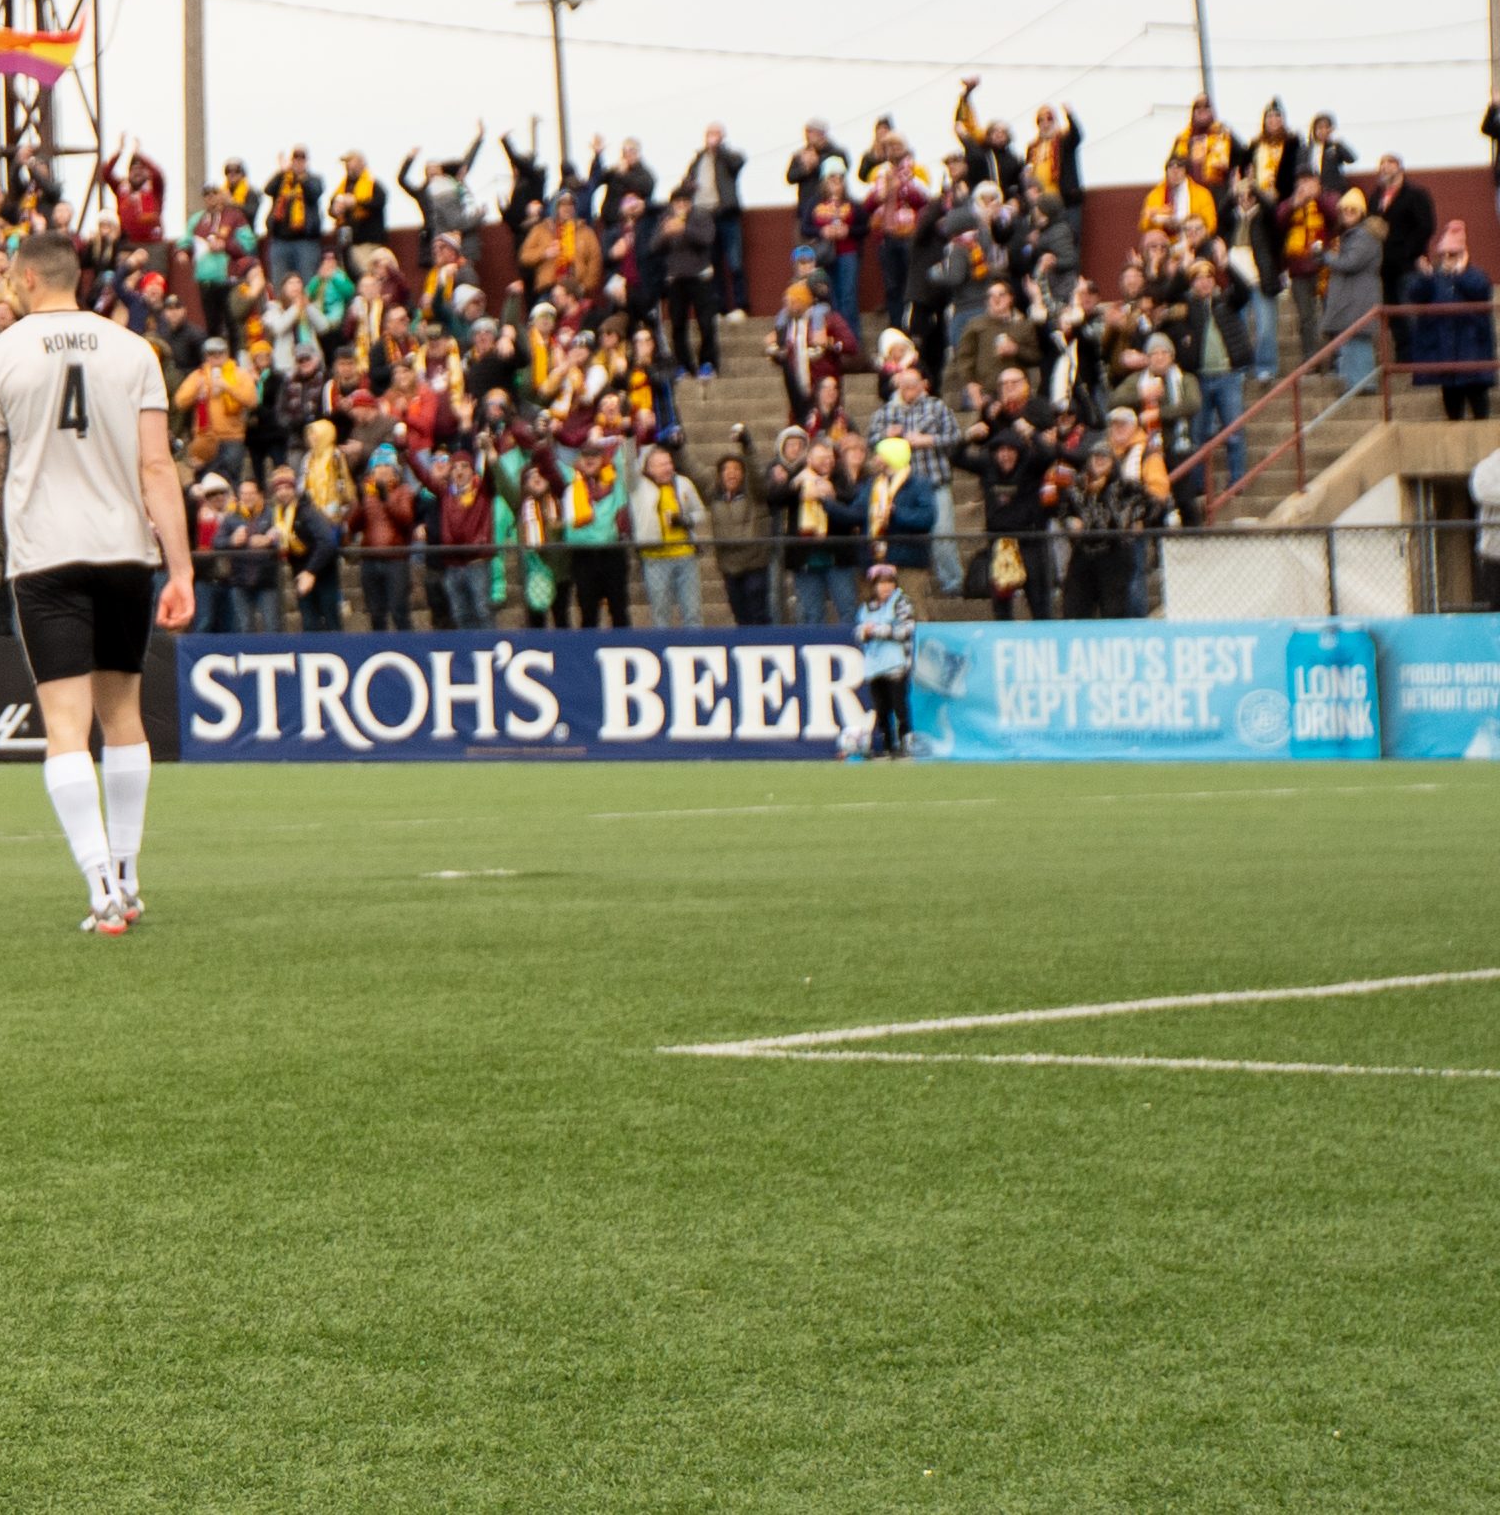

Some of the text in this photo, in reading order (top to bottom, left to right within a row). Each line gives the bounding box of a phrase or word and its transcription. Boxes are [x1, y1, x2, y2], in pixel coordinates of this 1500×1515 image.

[42, 332, 98, 354] ROMEO
[58, 363, 88, 439] 4
[994, 635, 1259, 685] FINLAND'S BEST
[1293, 664, 1368, 699] LONG
[190, 640, 877, 752] STROH'S BEER
[996, 683, 1080, 728] KEPT
[1088, 682, 1220, 728] SECRET.
[1401, 687, 1462, 710] DETROIT
[1295, 700, 1375, 741] DRINK
